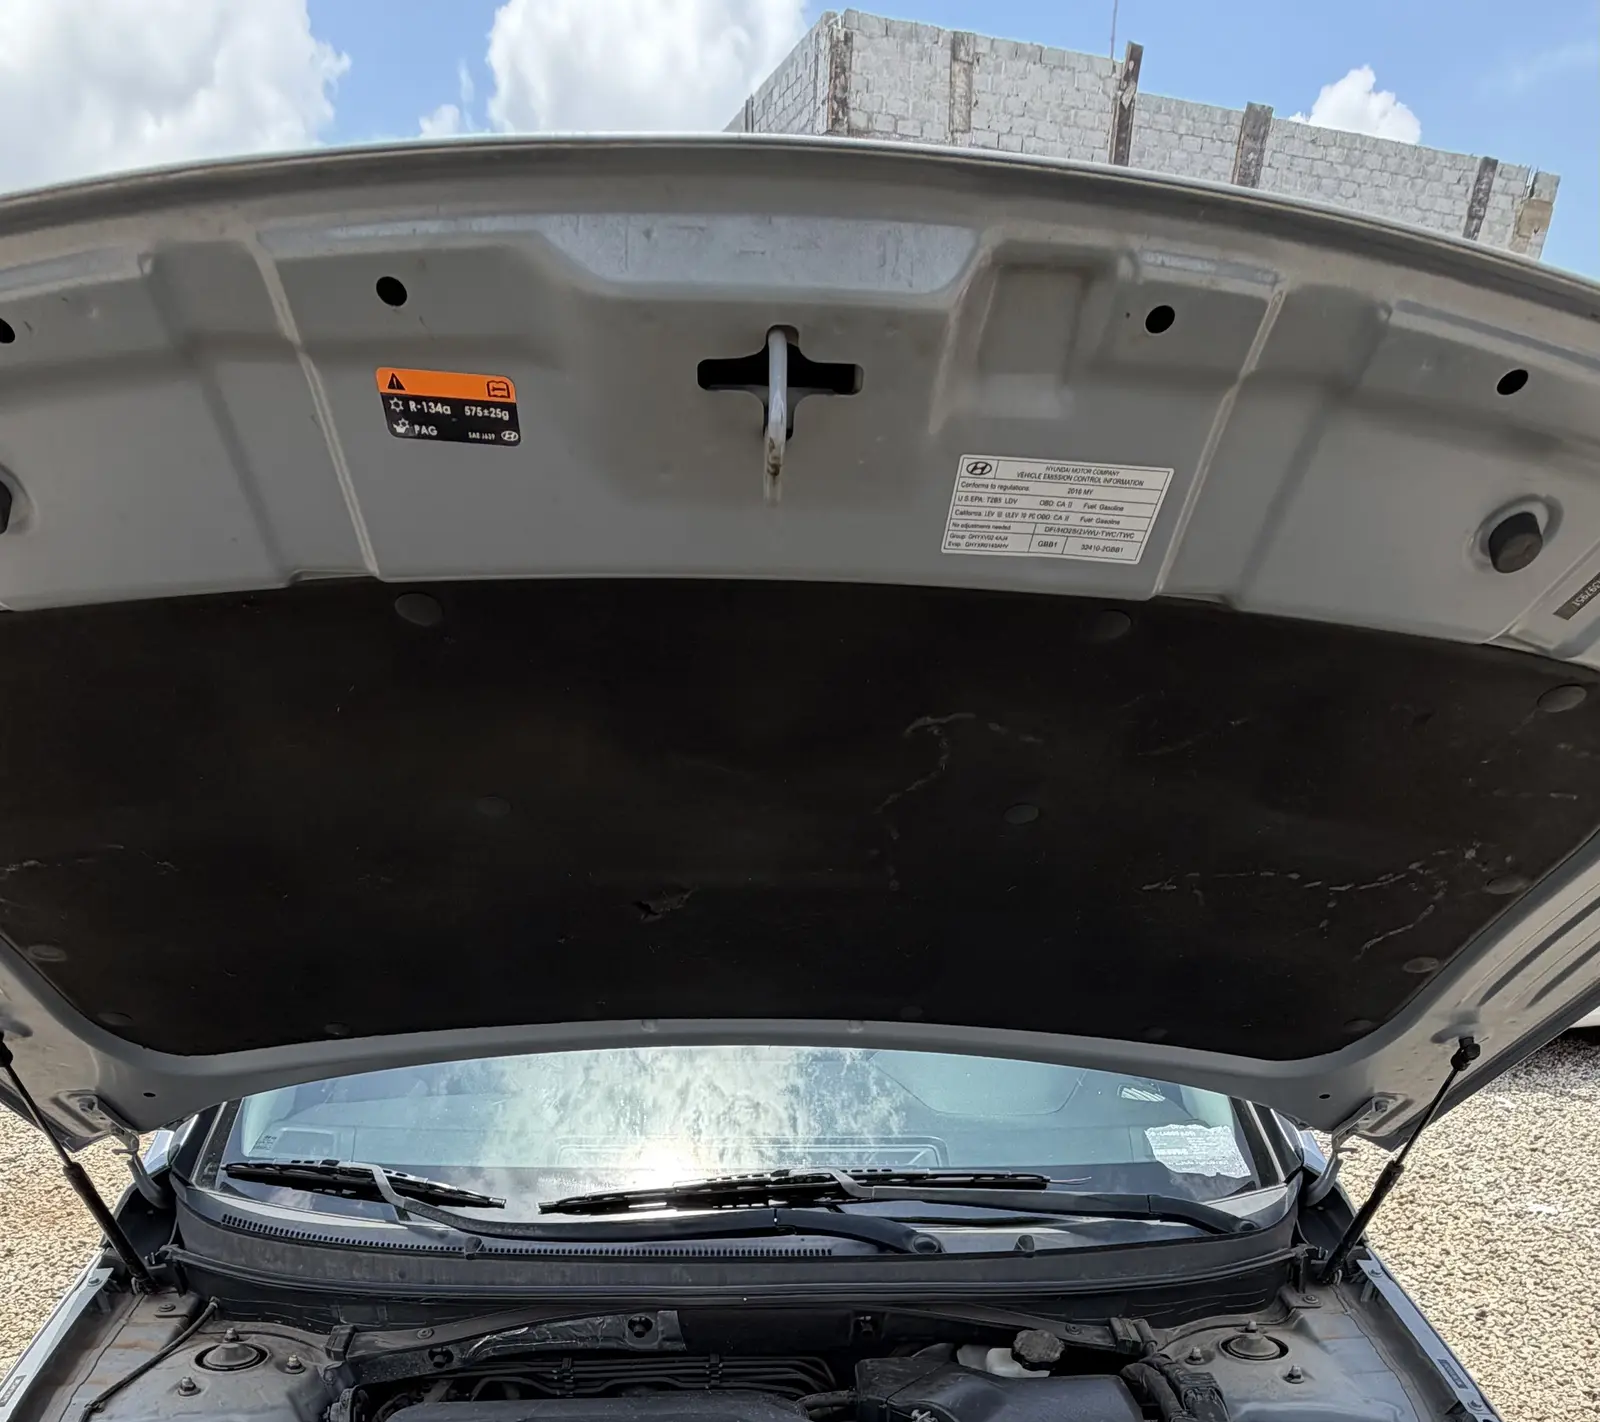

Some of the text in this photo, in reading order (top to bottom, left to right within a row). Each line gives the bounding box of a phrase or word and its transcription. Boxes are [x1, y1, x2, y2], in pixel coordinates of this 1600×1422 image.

[409, 400, 510, 421] R-134a 575±25g
[414, 424, 438, 436] PAG
[1046, 465, 1120, 476] HYUNDAI MOTOR COMPANY
[1017, 471, 1145, 487] VEHICLE EMISSION CONTROL INFORMATION
[961, 481, 989, 489] Conforms
[1083, 488, 1095, 496] MY
[1099, 503, 1125, 513] Gasoline
[1095, 516, 1121, 526] Gasoline
